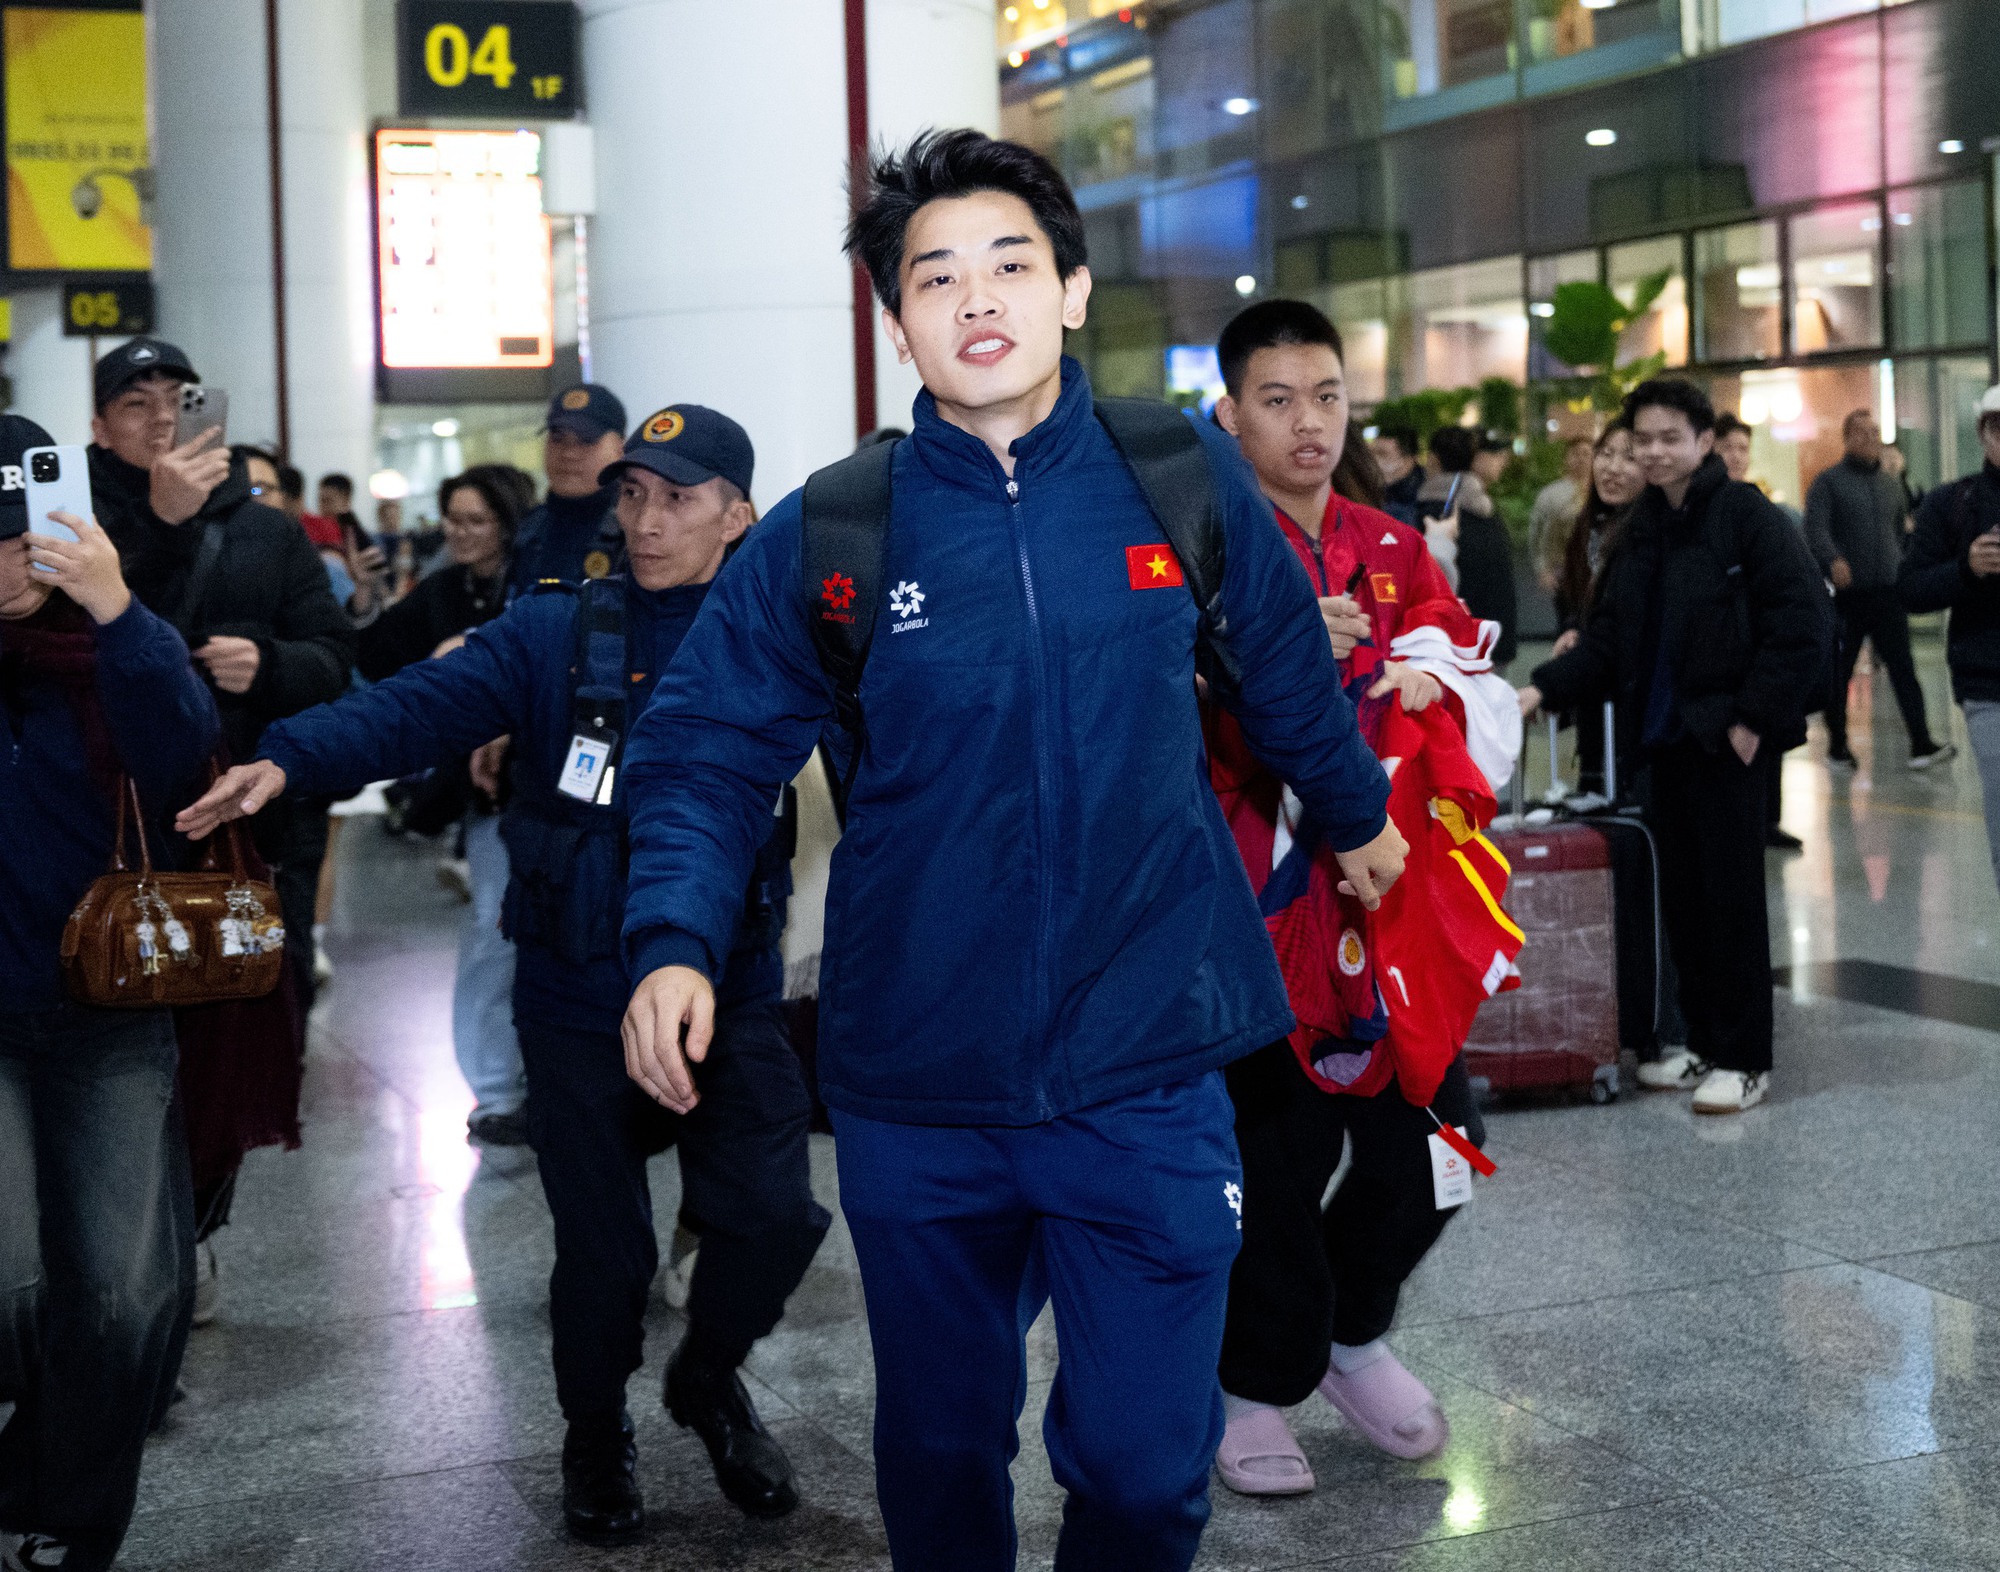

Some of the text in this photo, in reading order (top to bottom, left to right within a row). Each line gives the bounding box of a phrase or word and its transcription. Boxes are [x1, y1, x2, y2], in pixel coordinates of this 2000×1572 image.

[424, 22, 517, 89] 04
[531, 75, 563, 99] 1F
[71, 291, 119, 328] 05
[0, 465, 26, 491] R
[891, 617, 929, 634] JOGARBOLA
